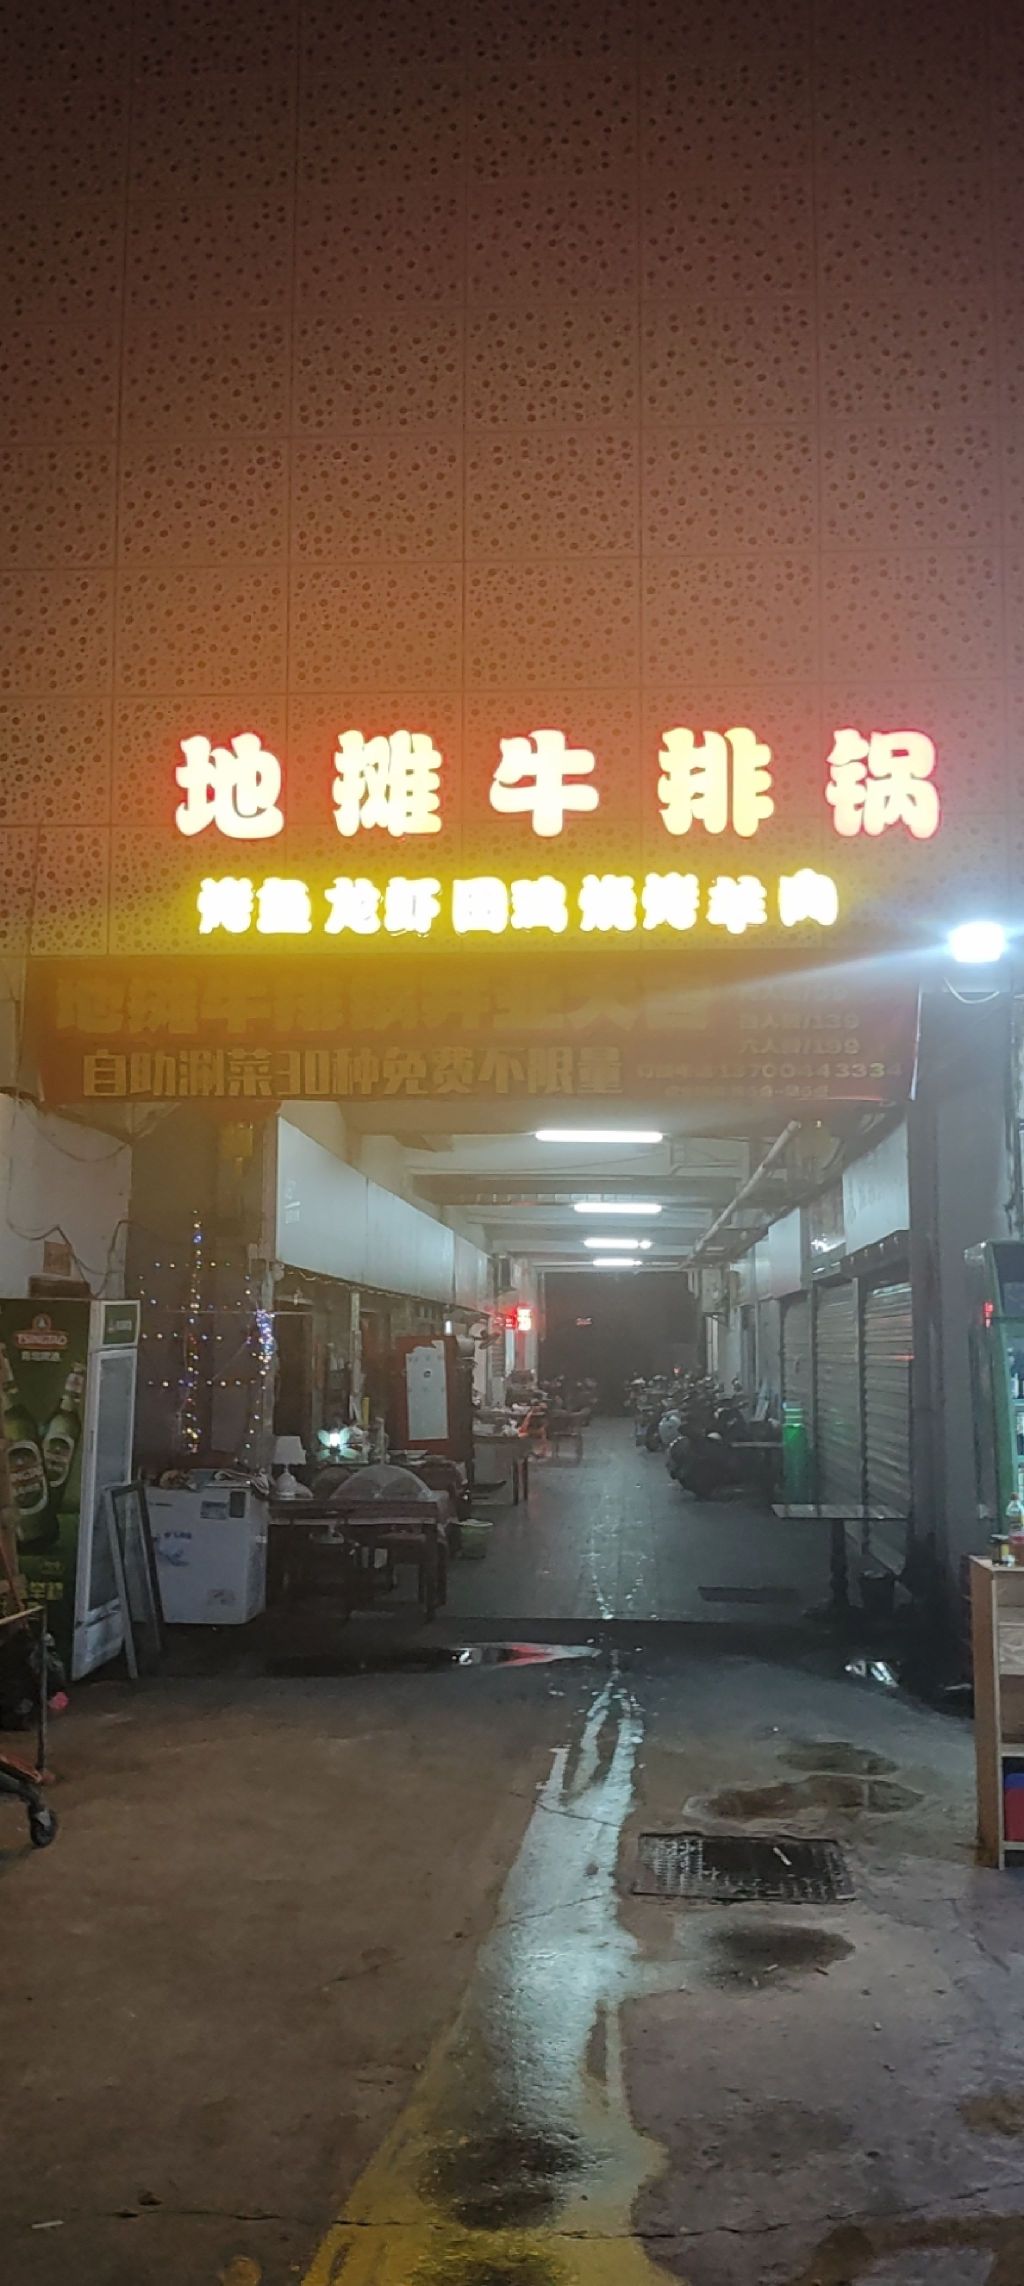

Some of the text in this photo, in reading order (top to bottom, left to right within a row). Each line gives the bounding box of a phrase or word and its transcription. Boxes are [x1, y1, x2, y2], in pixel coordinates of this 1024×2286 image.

[175, 729, 942, 839] 地摊牛排锅
[83, 1047, 623, 1096] 自助涮菜30种免费不限量
